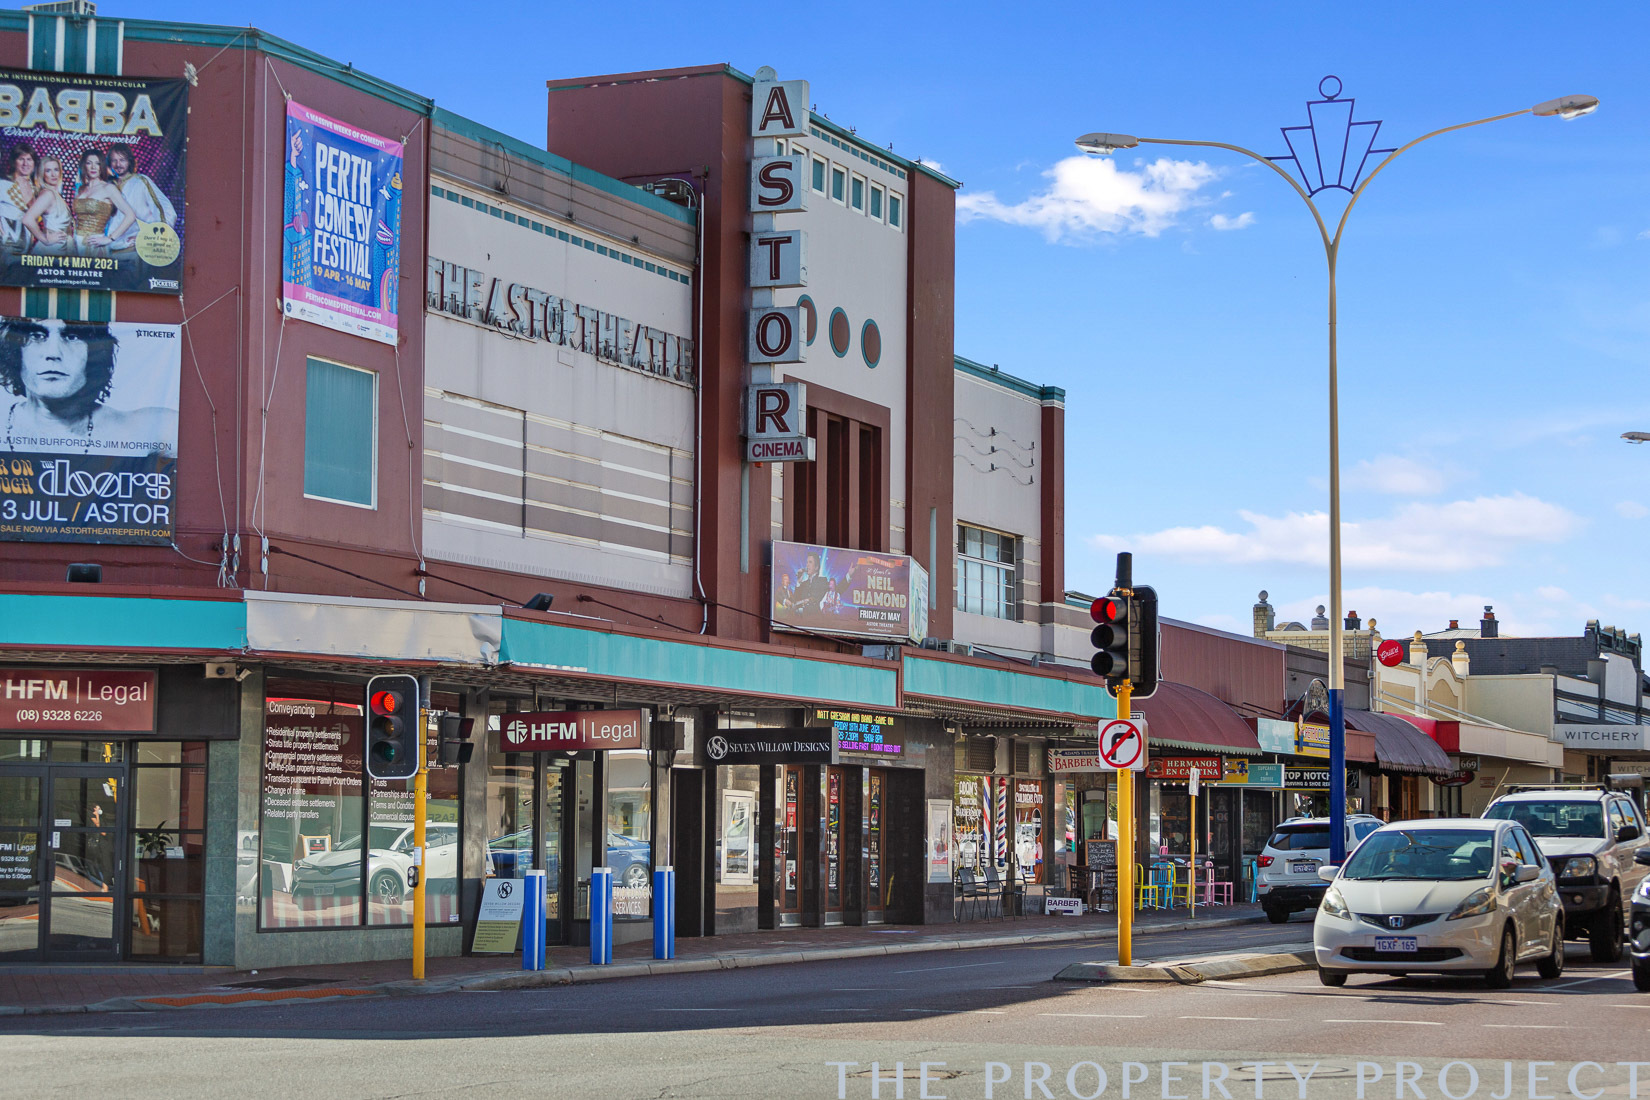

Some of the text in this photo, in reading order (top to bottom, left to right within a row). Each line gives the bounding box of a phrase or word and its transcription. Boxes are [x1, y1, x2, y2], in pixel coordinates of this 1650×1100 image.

[12, 73, 70, 84] INTERNATIONAL
[95, 80, 147, 88] SPECTACULAR
[3, 126, 35, 138] Direct
[34, 127, 60, 141] from
[100, 134, 142, 145] concerts!
[310, 113, 333, 129] MASSIVE
[333, 123, 352, 136] WEEKS
[352, 130, 360, 139] OF
[360, 134, 386, 149] COMEDY!
[316, 142, 373, 207] PERTH
[314, 190, 374, 245] COMEDY
[313, 229, 372, 279] FESTIVAL
[755, 85, 796, 434] ASTOR
[21, 254, 119, 270] FRIDAY 14 MAY 2021
[37, 268, 103, 278] ASTOR THEATRE
[313, 265, 371, 291] 19 APR 16 MAY
[39, 278, 100, 286] astortheatreperth.com
[305, 291, 382, 320] PERTHCOMEDYFESTIVAL.COM
[142, 329, 176, 339] TICKETEK
[485, 277, 582, 351] ASTOR
[576, 303, 695, 388] THEATRE
[3, 436, 38, 445] JUSTIN
[39, 437, 88, 447] BURFORD
[89, 439, 102, 448] AS
[103, 440, 119, 449] JIM
[121, 441, 172, 450] MORRISON
[751, 441, 804, 458] CINEMA
[11, 458, 35, 477] ON
[21, 500, 68, 522] JUL
[84, 502, 170, 525] ASTOR
[0, 524, 171, 537] SALE NOW VIA ASTORTHEATREPERTH.COM
[867, 575, 895, 592] NEIL
[852, 589, 907, 609] DIAMOND
[859, 609, 901, 622] FRIDAY 21 MAY
[5, 679, 147, 705] HFM Legal
[16, 709, 103, 722] (08) 9328 6226
[269, 700, 316, 719] Conveyancing
[816, 710, 829, 720] MATT
[851, 713, 860, 723] AND
[861, 714, 873, 724] BAND
[887, 717, 894, 726] ON
[269, 726, 342, 740] Residential property settlements
[531, 720, 637, 742] HFM Legal
[834, 720, 880, 734] FRIDAY JUNE 2021
[1564, 731, 1639, 741] WITCHERY
[268, 738, 339, 751] Strata title property settlements
[729, 741, 830, 753] SEVEN WILLOW DESIGNS
[841, 741, 858, 750] SELLING
[858, 742, 869, 751] FAST
[268, 750, 296, 760] Commercial
[297, 753, 316, 763] property
[316, 753, 343, 763] settlements
[296, 764, 316, 774] property
[316, 765, 342, 774] settlements
[1054, 757, 1093, 771] BARBER
[1167, 760, 1218, 768] HERMANOS
[1461, 760, 1477, 769] 669
[1179, 768, 1219, 776] CATINA
[1284, 771, 1301, 780] TOP
[267, 773, 290, 784] Transfers
[291, 775, 311, 785] pursuant
[317, 776, 333, 786] Family
[333, 777, 346, 785] Court
[346, 777, 362, 786] Orders
[373, 779, 388, 787] Trusts
[267, 785, 286, 796] Change
[286, 786, 292, 795] of
[373, 790, 400, 800] Partnerships
[267, 797, 291, 807] Deceased
[309, 798, 336, 808] settlements
[373, 801, 415, 810] Terms and Condition
[266, 808, 285, 818] Related
[286, 810, 299, 820] party
[372, 812, 399, 821] Commercial
[17, 843, 36, 852] Legal
[14, 866, 31, 874] Friday
[615, 901, 642, 915] SERVICES
[1377, 941, 1397, 950] 1GXF
